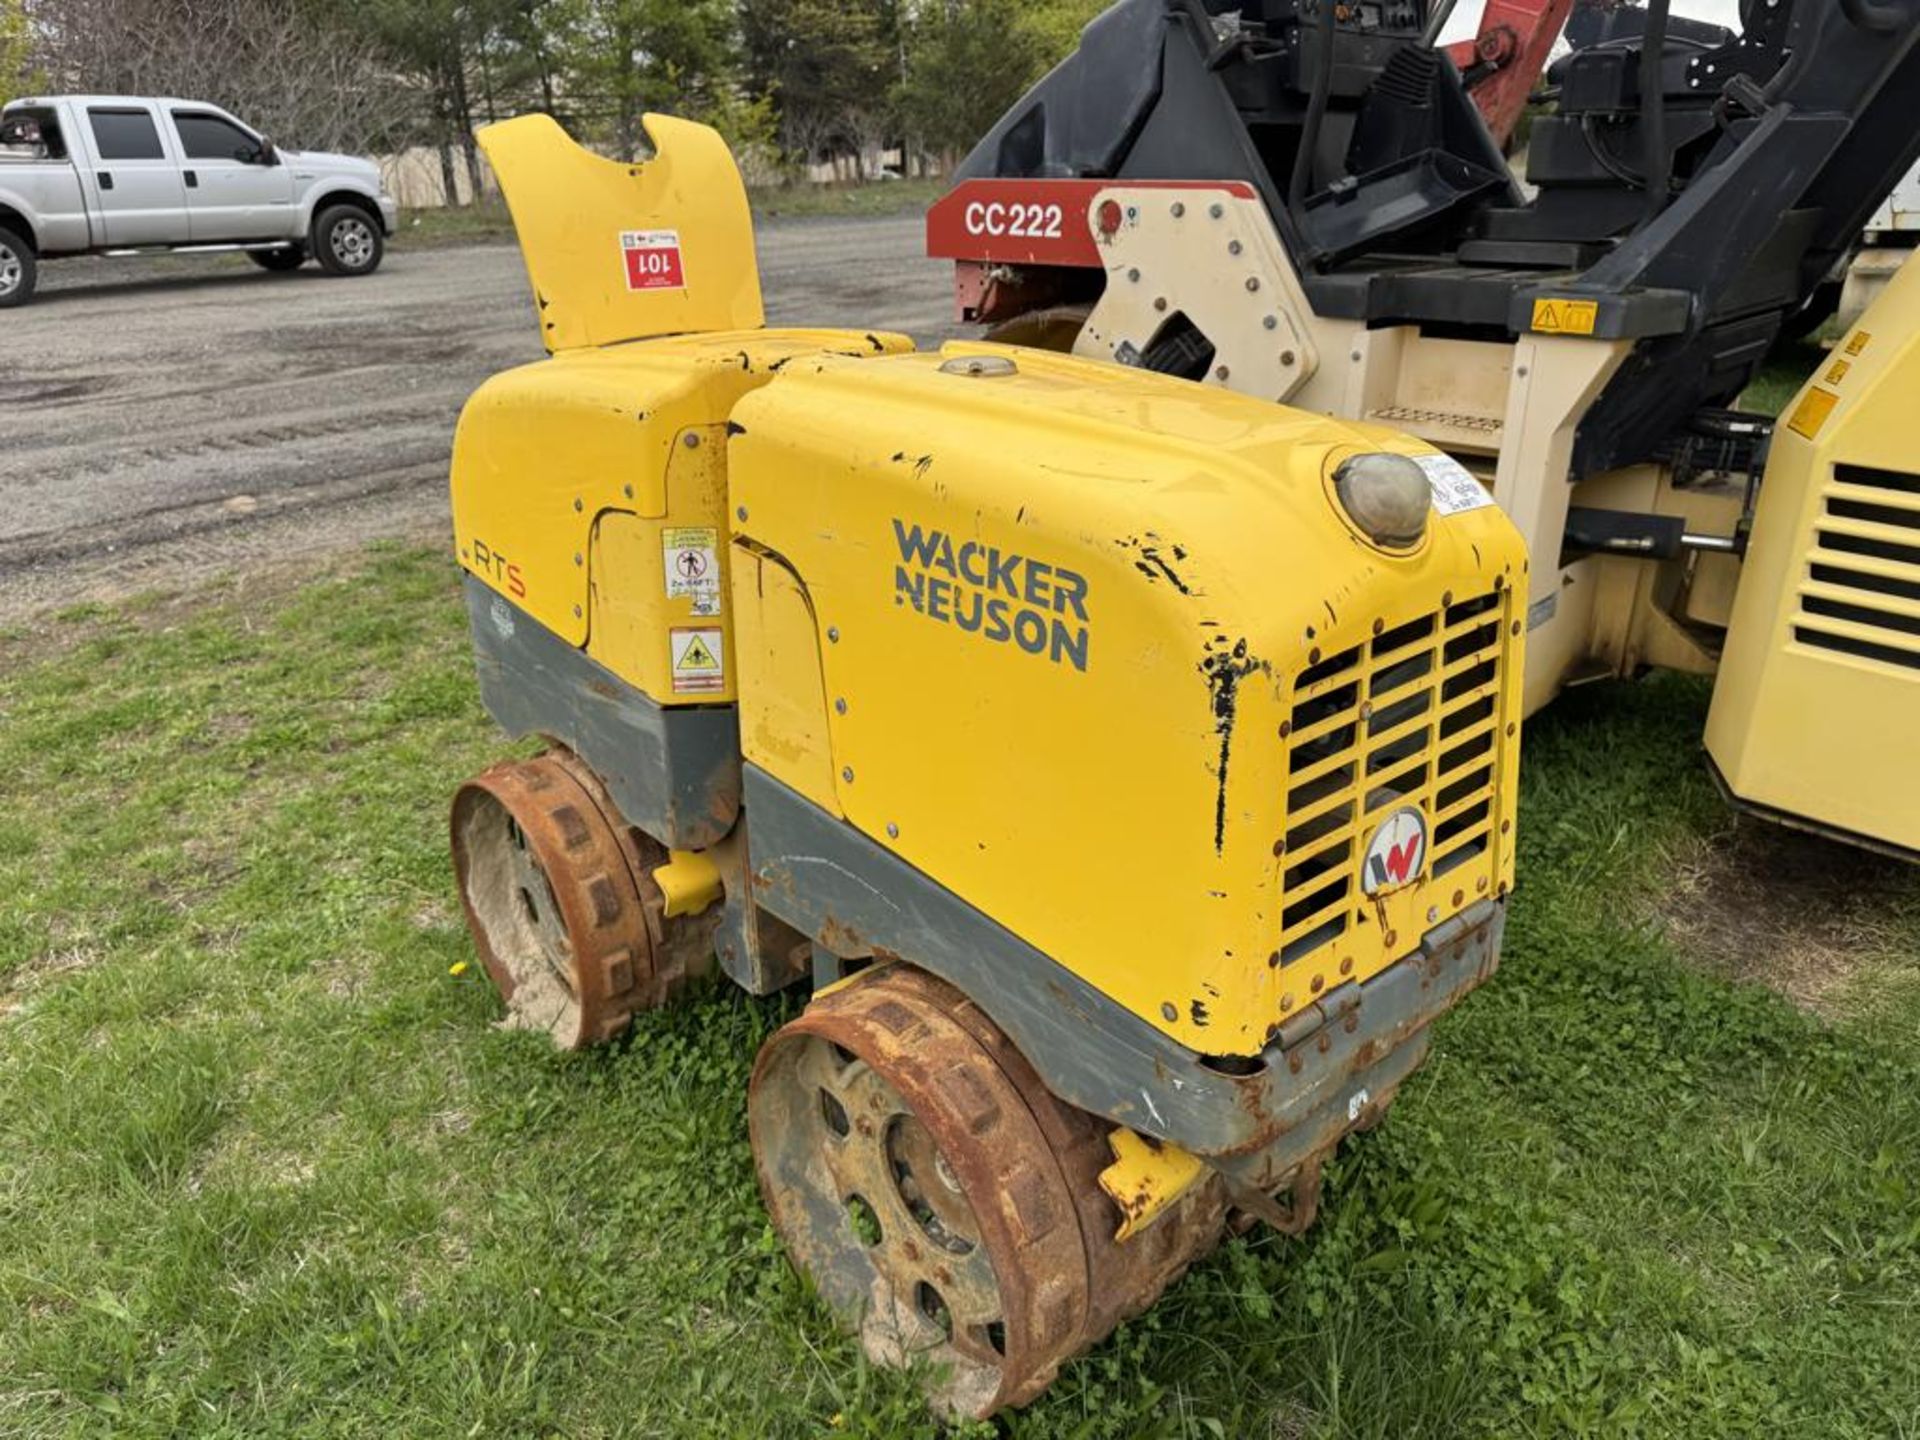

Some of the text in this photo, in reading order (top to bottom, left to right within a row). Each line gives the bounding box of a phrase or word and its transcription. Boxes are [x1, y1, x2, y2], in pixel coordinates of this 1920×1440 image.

[965, 202, 1062, 238] CC222
[639, 253, 672, 274] 101
[473, 539, 526, 598] RTS
[892, 518, 1090, 622] WACKER
[895, 565, 1089, 672] NEUSON
